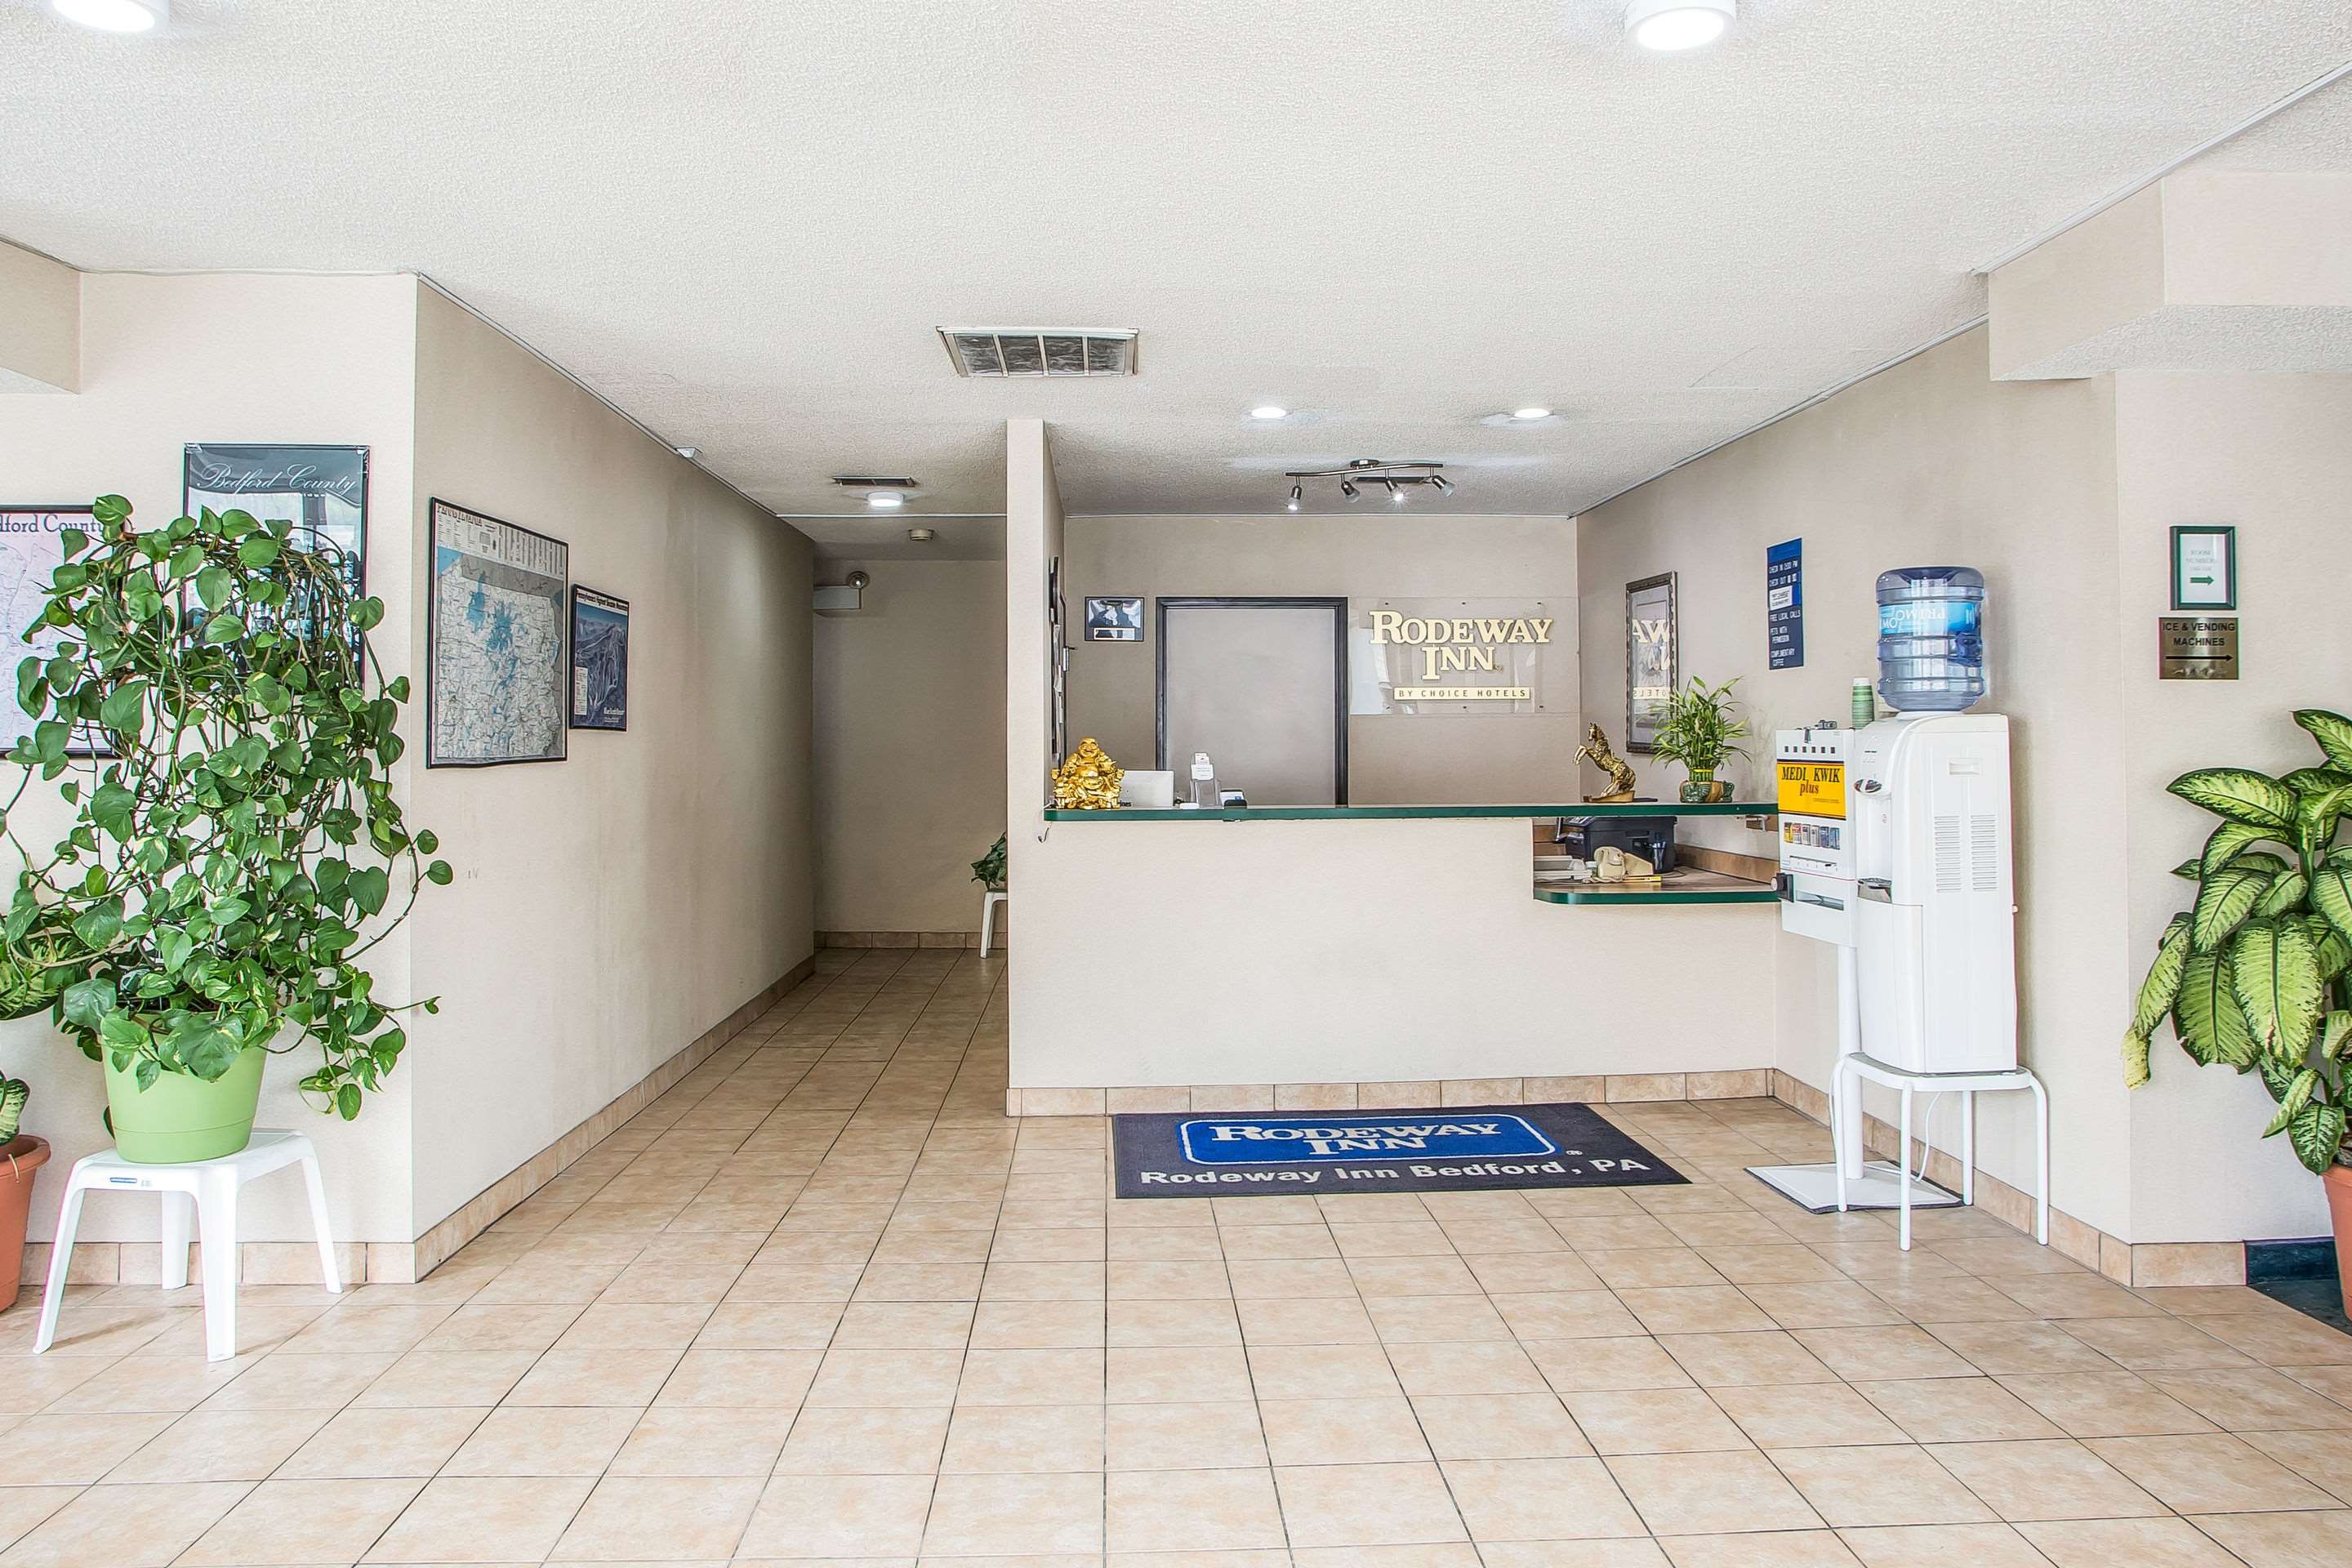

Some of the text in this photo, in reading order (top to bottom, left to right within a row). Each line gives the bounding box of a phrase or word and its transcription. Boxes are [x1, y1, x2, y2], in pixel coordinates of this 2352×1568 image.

[196, 462, 357, 496] Bedford County
[1368, 611, 1554, 645] RODEWAY
[2163, 622, 2235, 631] ICE & VENDING
[2173, 637, 2225, 646] MACHINES
[1421, 646, 1495, 681] INN
[1399, 689, 1526, 697] BY CHOICE HOTELS
[1782, 766, 1841, 782] MEDI KWIK
[1800, 779, 1820, 796] plus
[1208, 1124, 1502, 1142] RODEWAY
[1302, 1138, 1428, 1156] INN
[1140, 1169, 1321, 1184] Rodeway
[1333, 1167, 1400, 1180] Inn
[1588, 1158, 1651, 1173] PA
